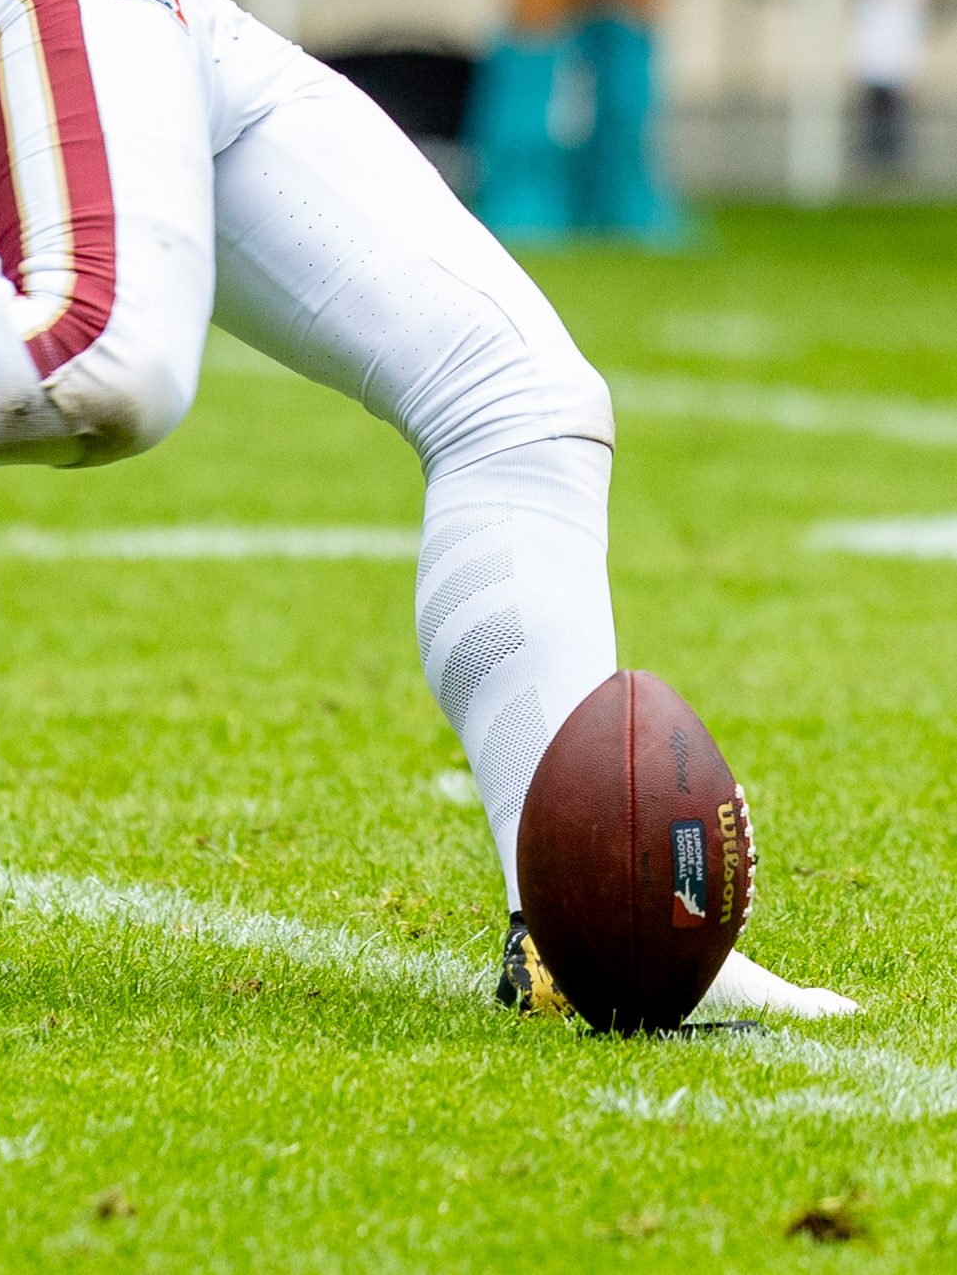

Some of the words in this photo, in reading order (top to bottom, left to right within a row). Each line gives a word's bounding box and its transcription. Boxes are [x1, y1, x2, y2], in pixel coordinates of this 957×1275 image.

[675, 829, 687, 879] FOOTBALL
[684, 828, 694, 866] LEAGUE
[692, 827, 703, 881] EUROPEAN
[717, 800, 740, 924] Wilson
